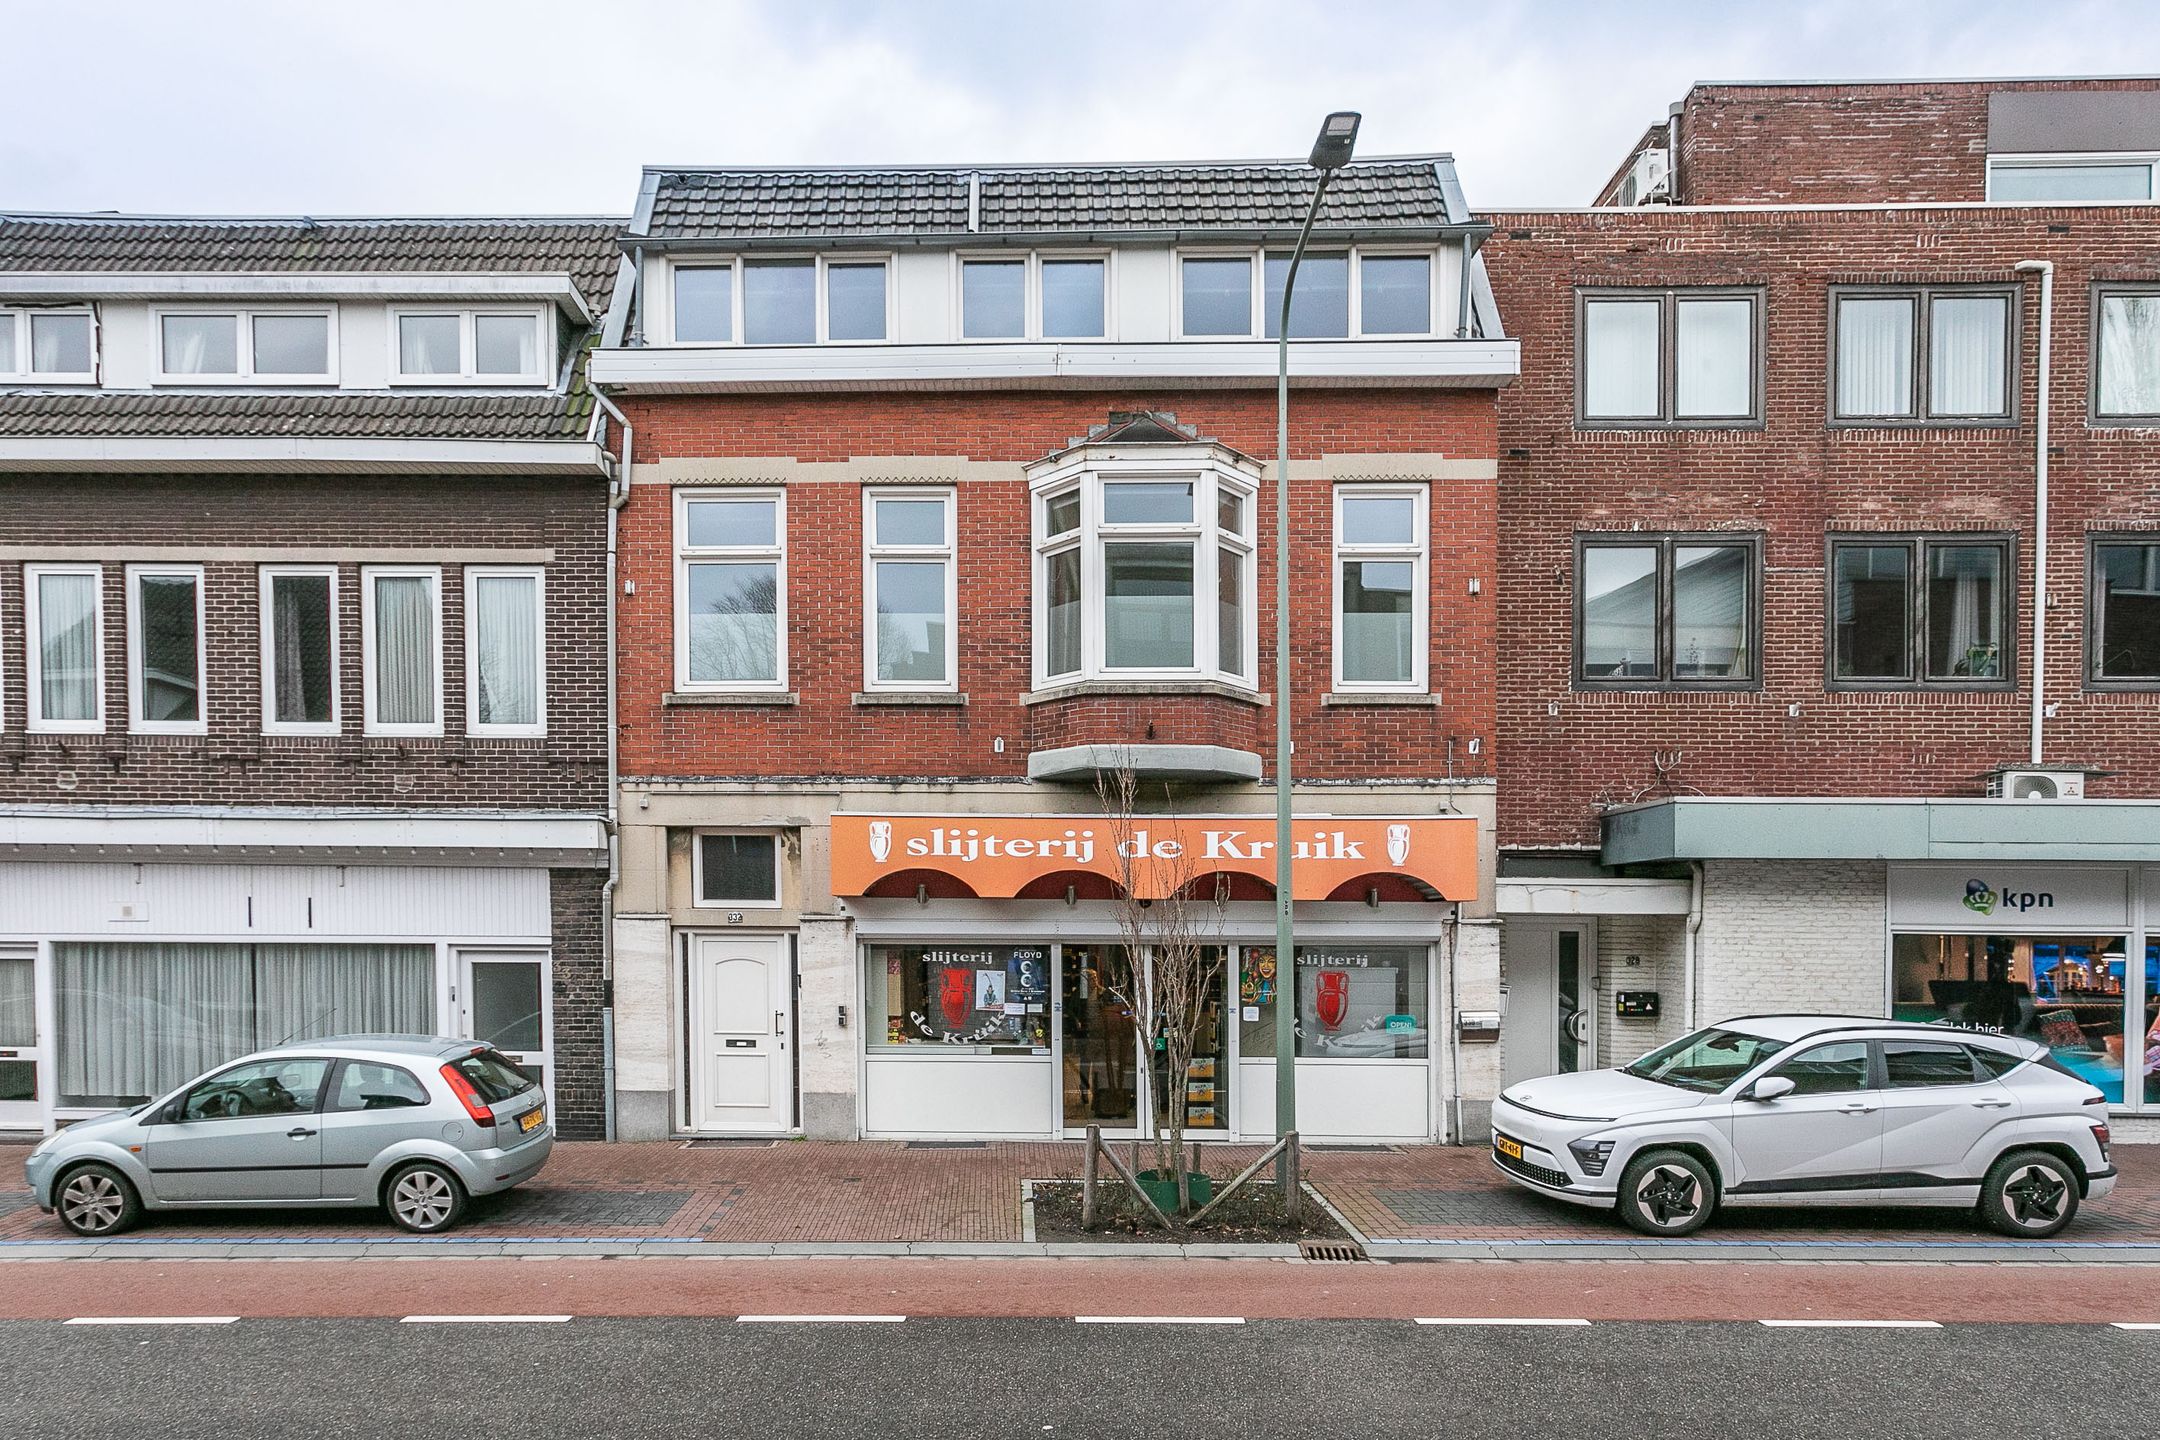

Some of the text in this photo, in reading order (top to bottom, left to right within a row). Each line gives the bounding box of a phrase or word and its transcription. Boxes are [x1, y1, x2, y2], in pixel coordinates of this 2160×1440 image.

[906, 828, 1094, 863] slijterij
[1116, 830, 1184, 859] de
[2002, 888, 2054, 912] kpn
[922, 951, 993, 965] slijterij
[1013, 951, 1042, 959] FLOYD
[1296, 954, 1368, 968] slijterij
[910, 1010, 934, 1036] de
